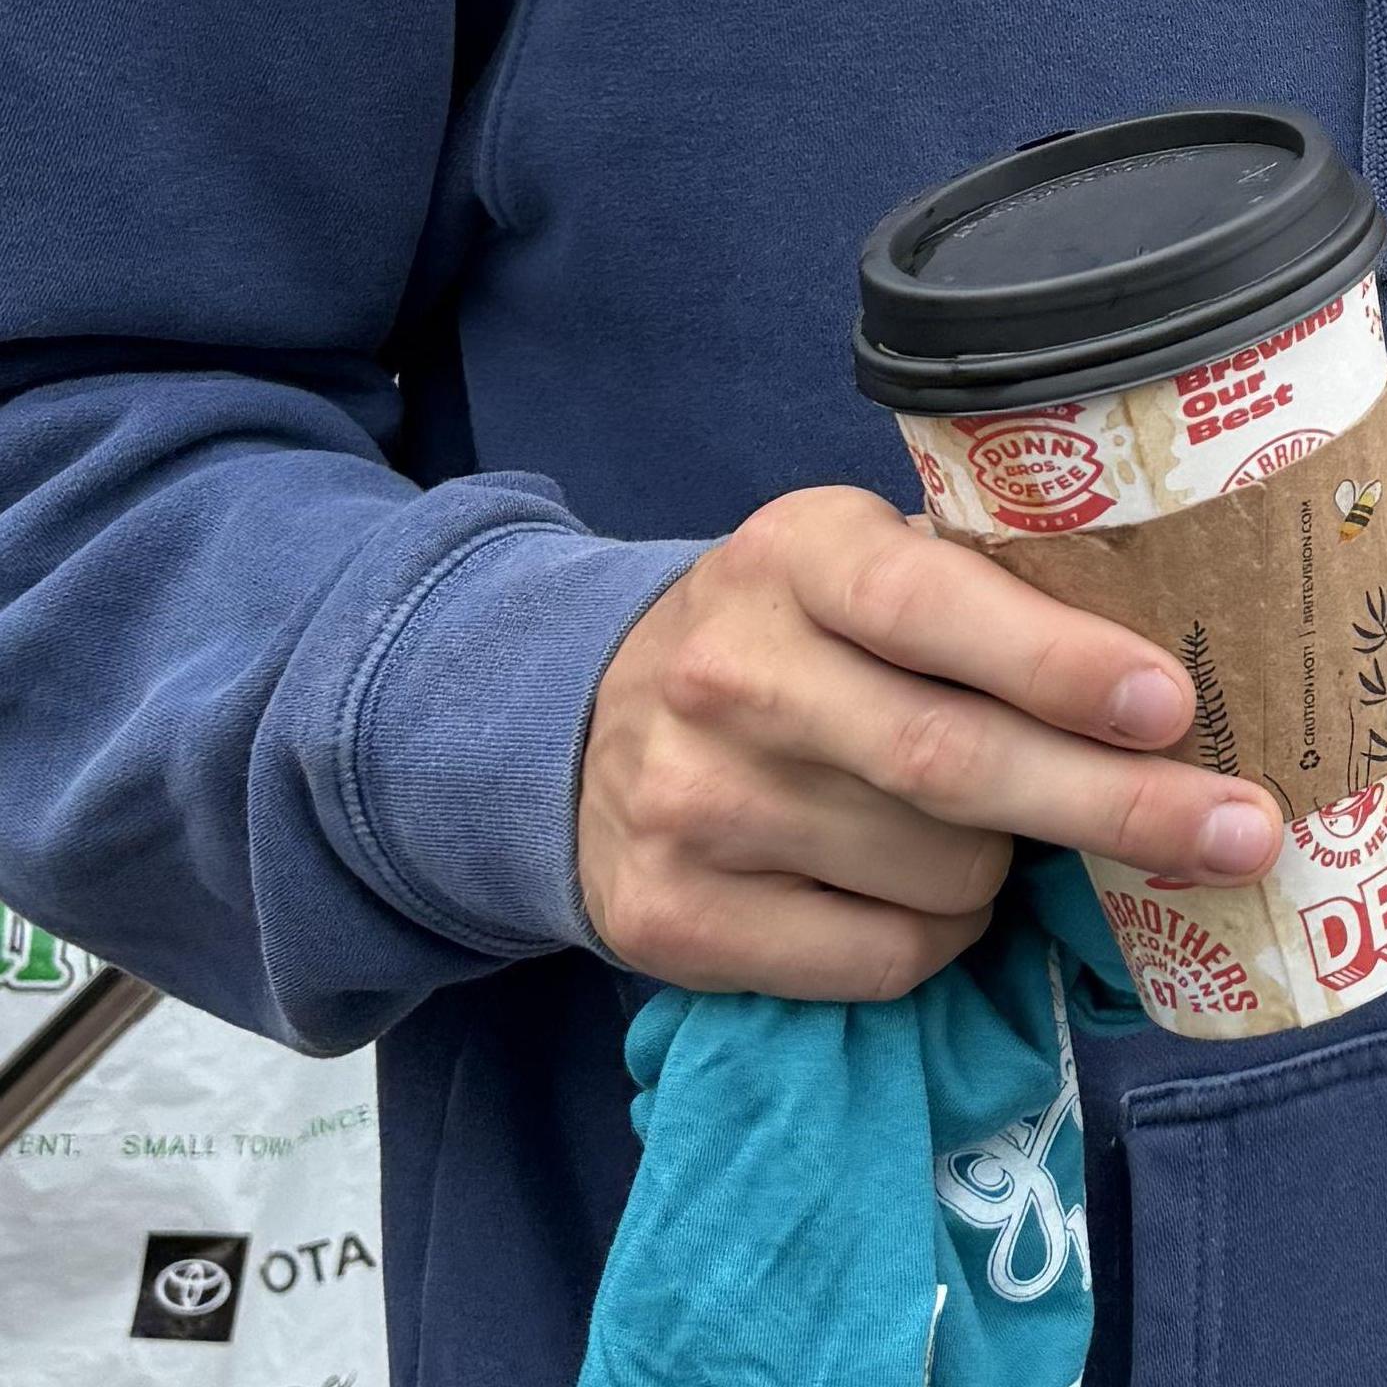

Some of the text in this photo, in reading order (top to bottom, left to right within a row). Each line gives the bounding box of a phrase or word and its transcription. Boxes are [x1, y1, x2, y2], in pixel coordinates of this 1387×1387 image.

[1173, 295, 1344, 397] Brewing
[1182, 370, 1267, 418] Our
[1186, 383, 1294, 446] Best
[982, 436, 1075, 467] DUNN
[1005, 460, 1062, 477] BROS.
[992, 465, 1087, 498] COFFEE
[1304, 682, 1316, 746] CAUTION
[1309, 841, 1361, 869] YOUR
[1101, 890, 1259, 1012] BROTHERS
[1137, 931, 1223, 1012] COMPANY
[18, 1132, 82, 1158] ENT.
[121, 1132, 218, 1158] SMALL
[259, 1231, 377, 1294] OTA
